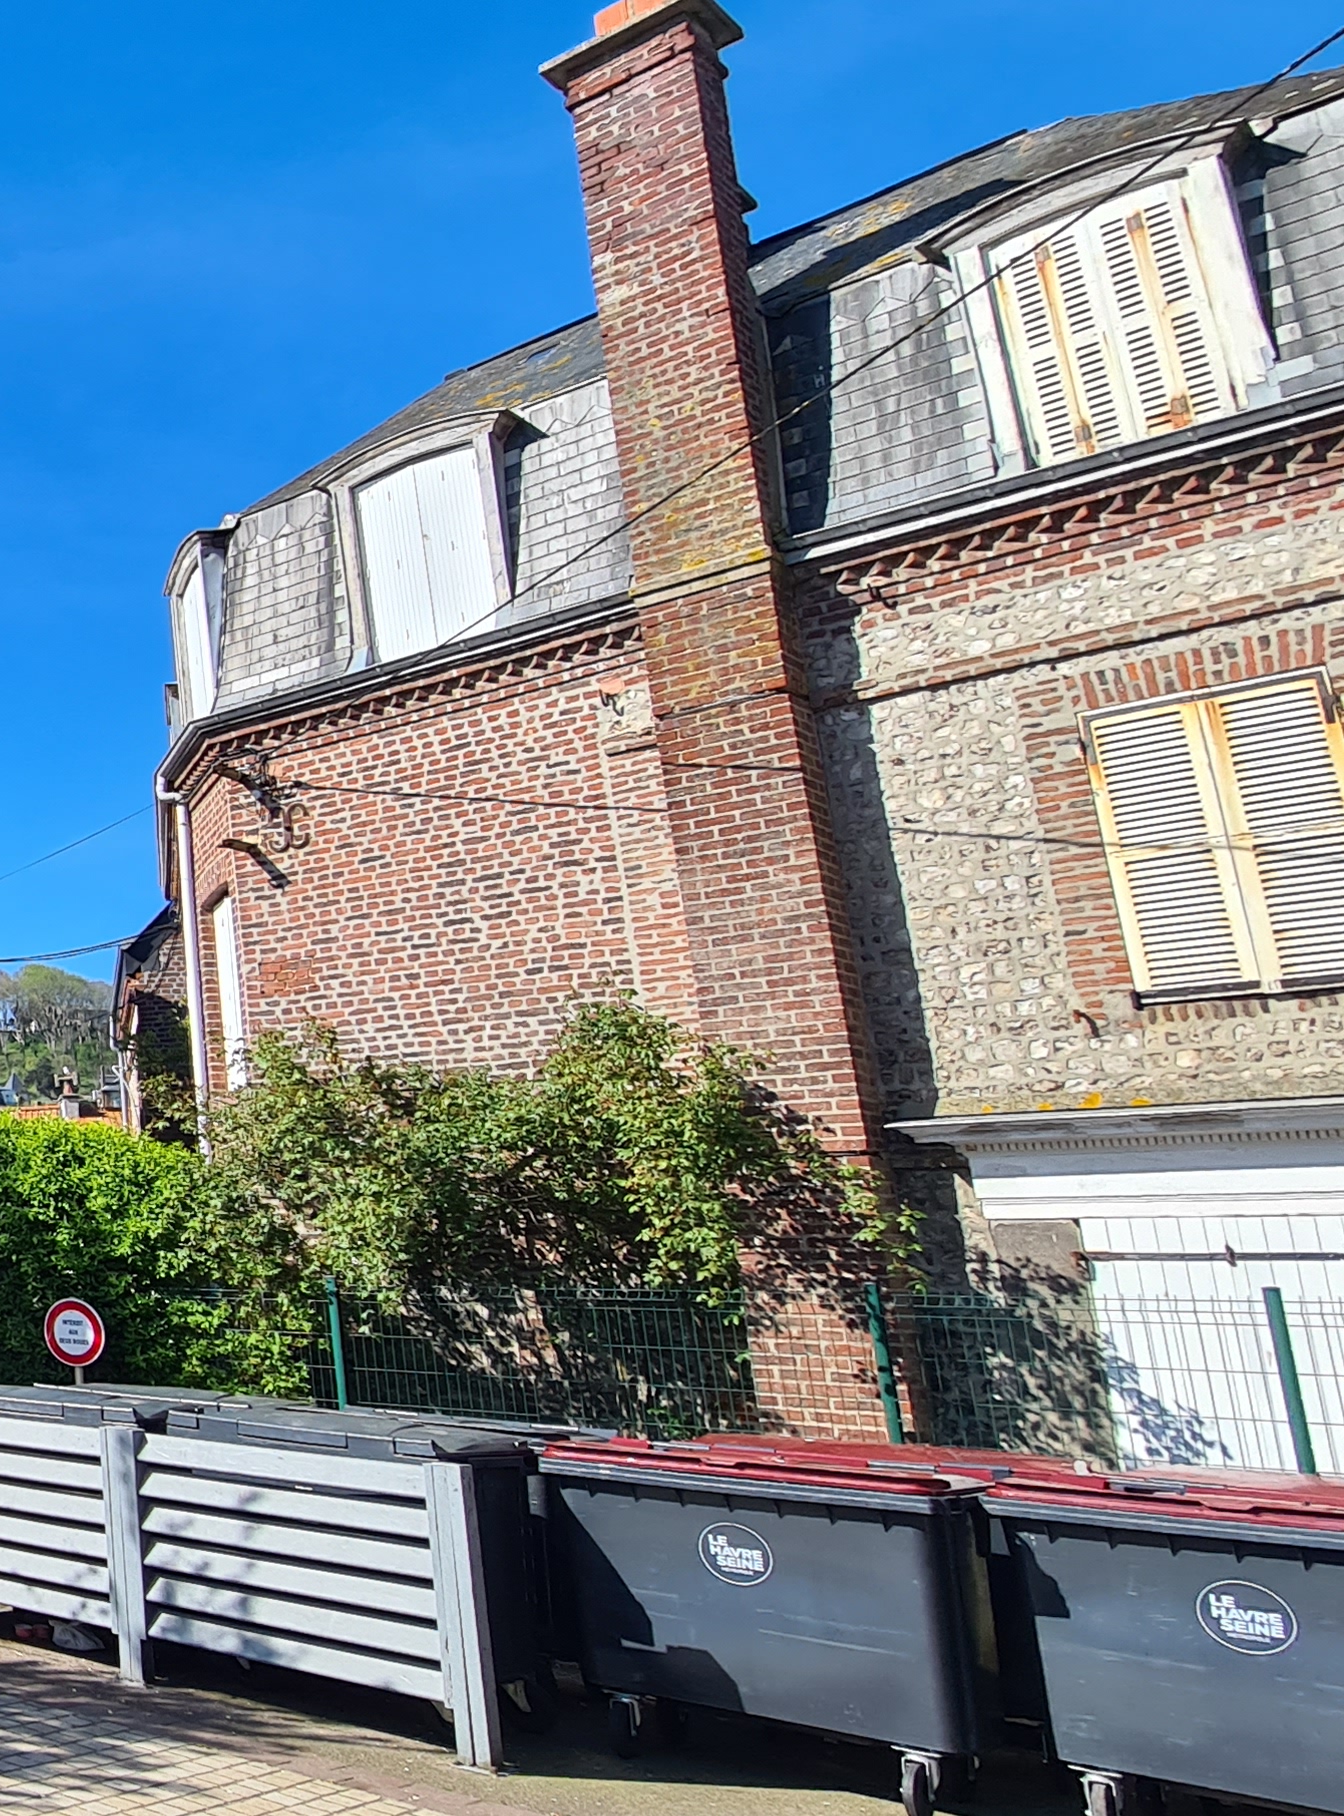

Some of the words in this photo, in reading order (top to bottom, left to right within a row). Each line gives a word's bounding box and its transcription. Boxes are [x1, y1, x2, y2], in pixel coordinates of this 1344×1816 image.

[707, 1534, 728, 1546] LE
[710, 1545, 763, 1561] HAVRE
[716, 1555, 765, 1572] SEINE
[1208, 1593, 1236, 1608] LE
[1211, 1605, 1284, 1626] HAVRE
[1220, 1618, 1286, 1639] SEINE
